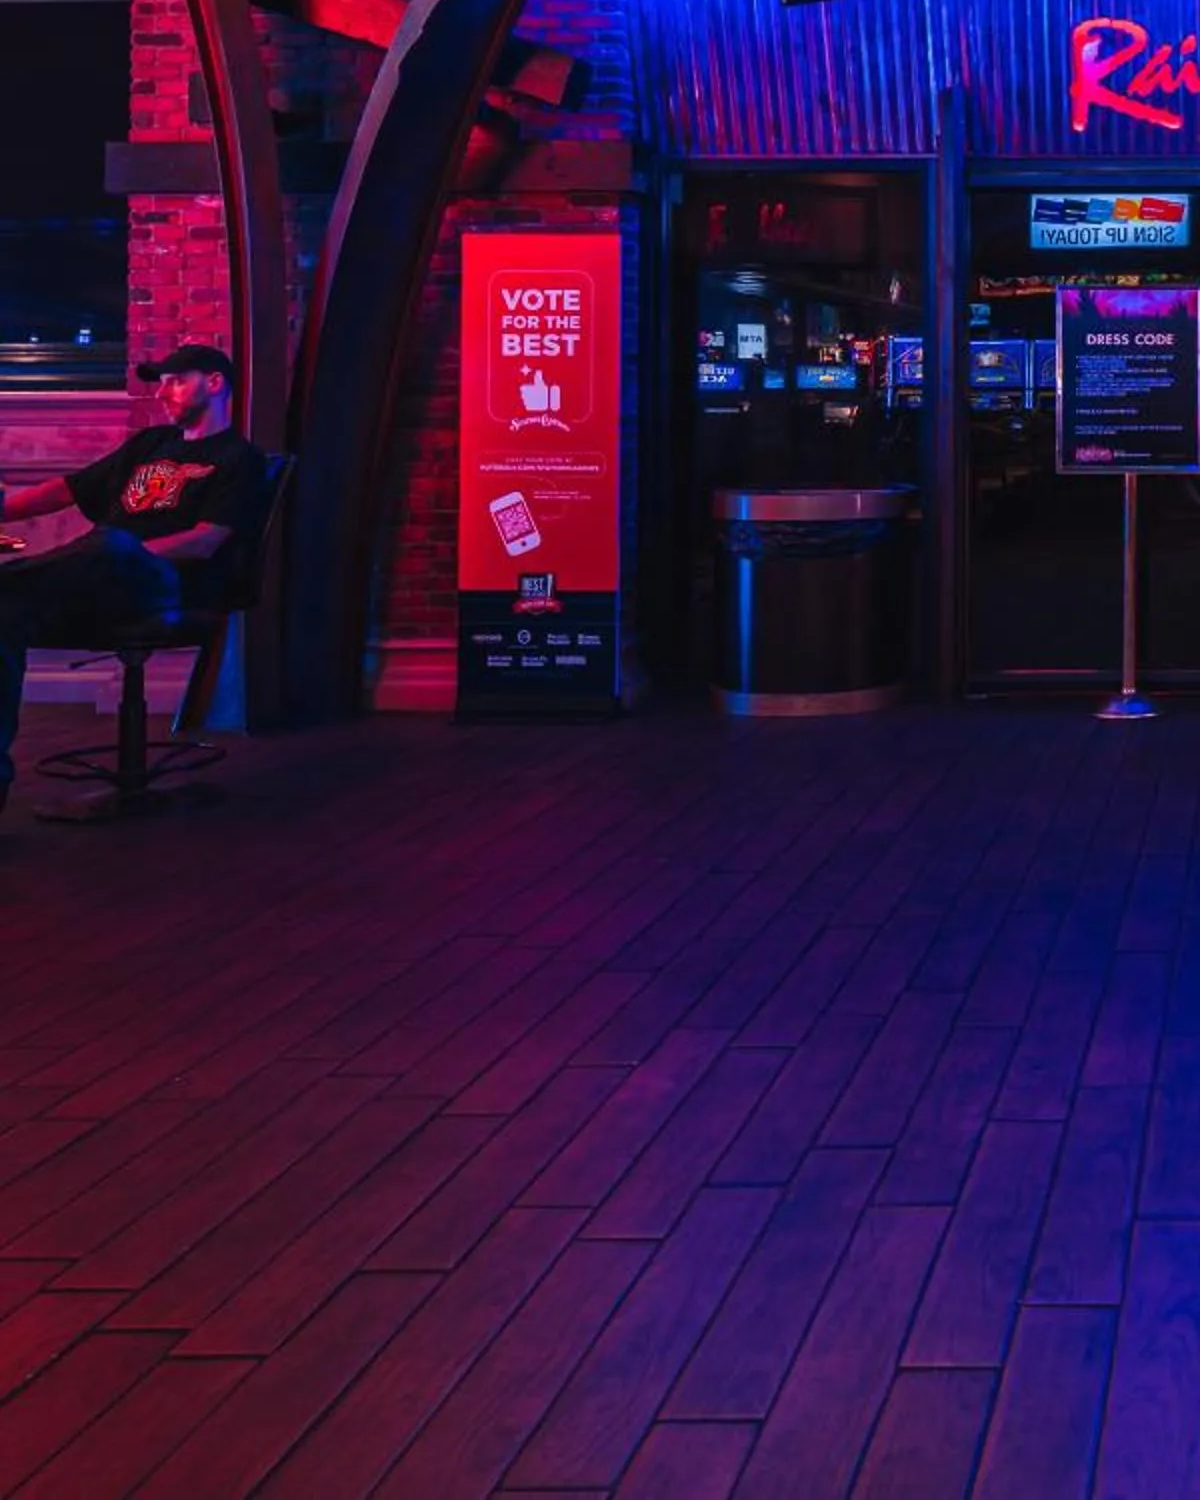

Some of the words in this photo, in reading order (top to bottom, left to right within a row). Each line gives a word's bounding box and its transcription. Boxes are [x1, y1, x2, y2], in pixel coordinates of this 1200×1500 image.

[501, 289, 581, 311] VOTE
[502, 315, 542, 330] FOR
[546, 315, 581, 330] THE
[502, 334, 580, 357] BEST
[1086, 333, 1129, 346] DRESS
[1135, 333, 1175, 346] CODE
